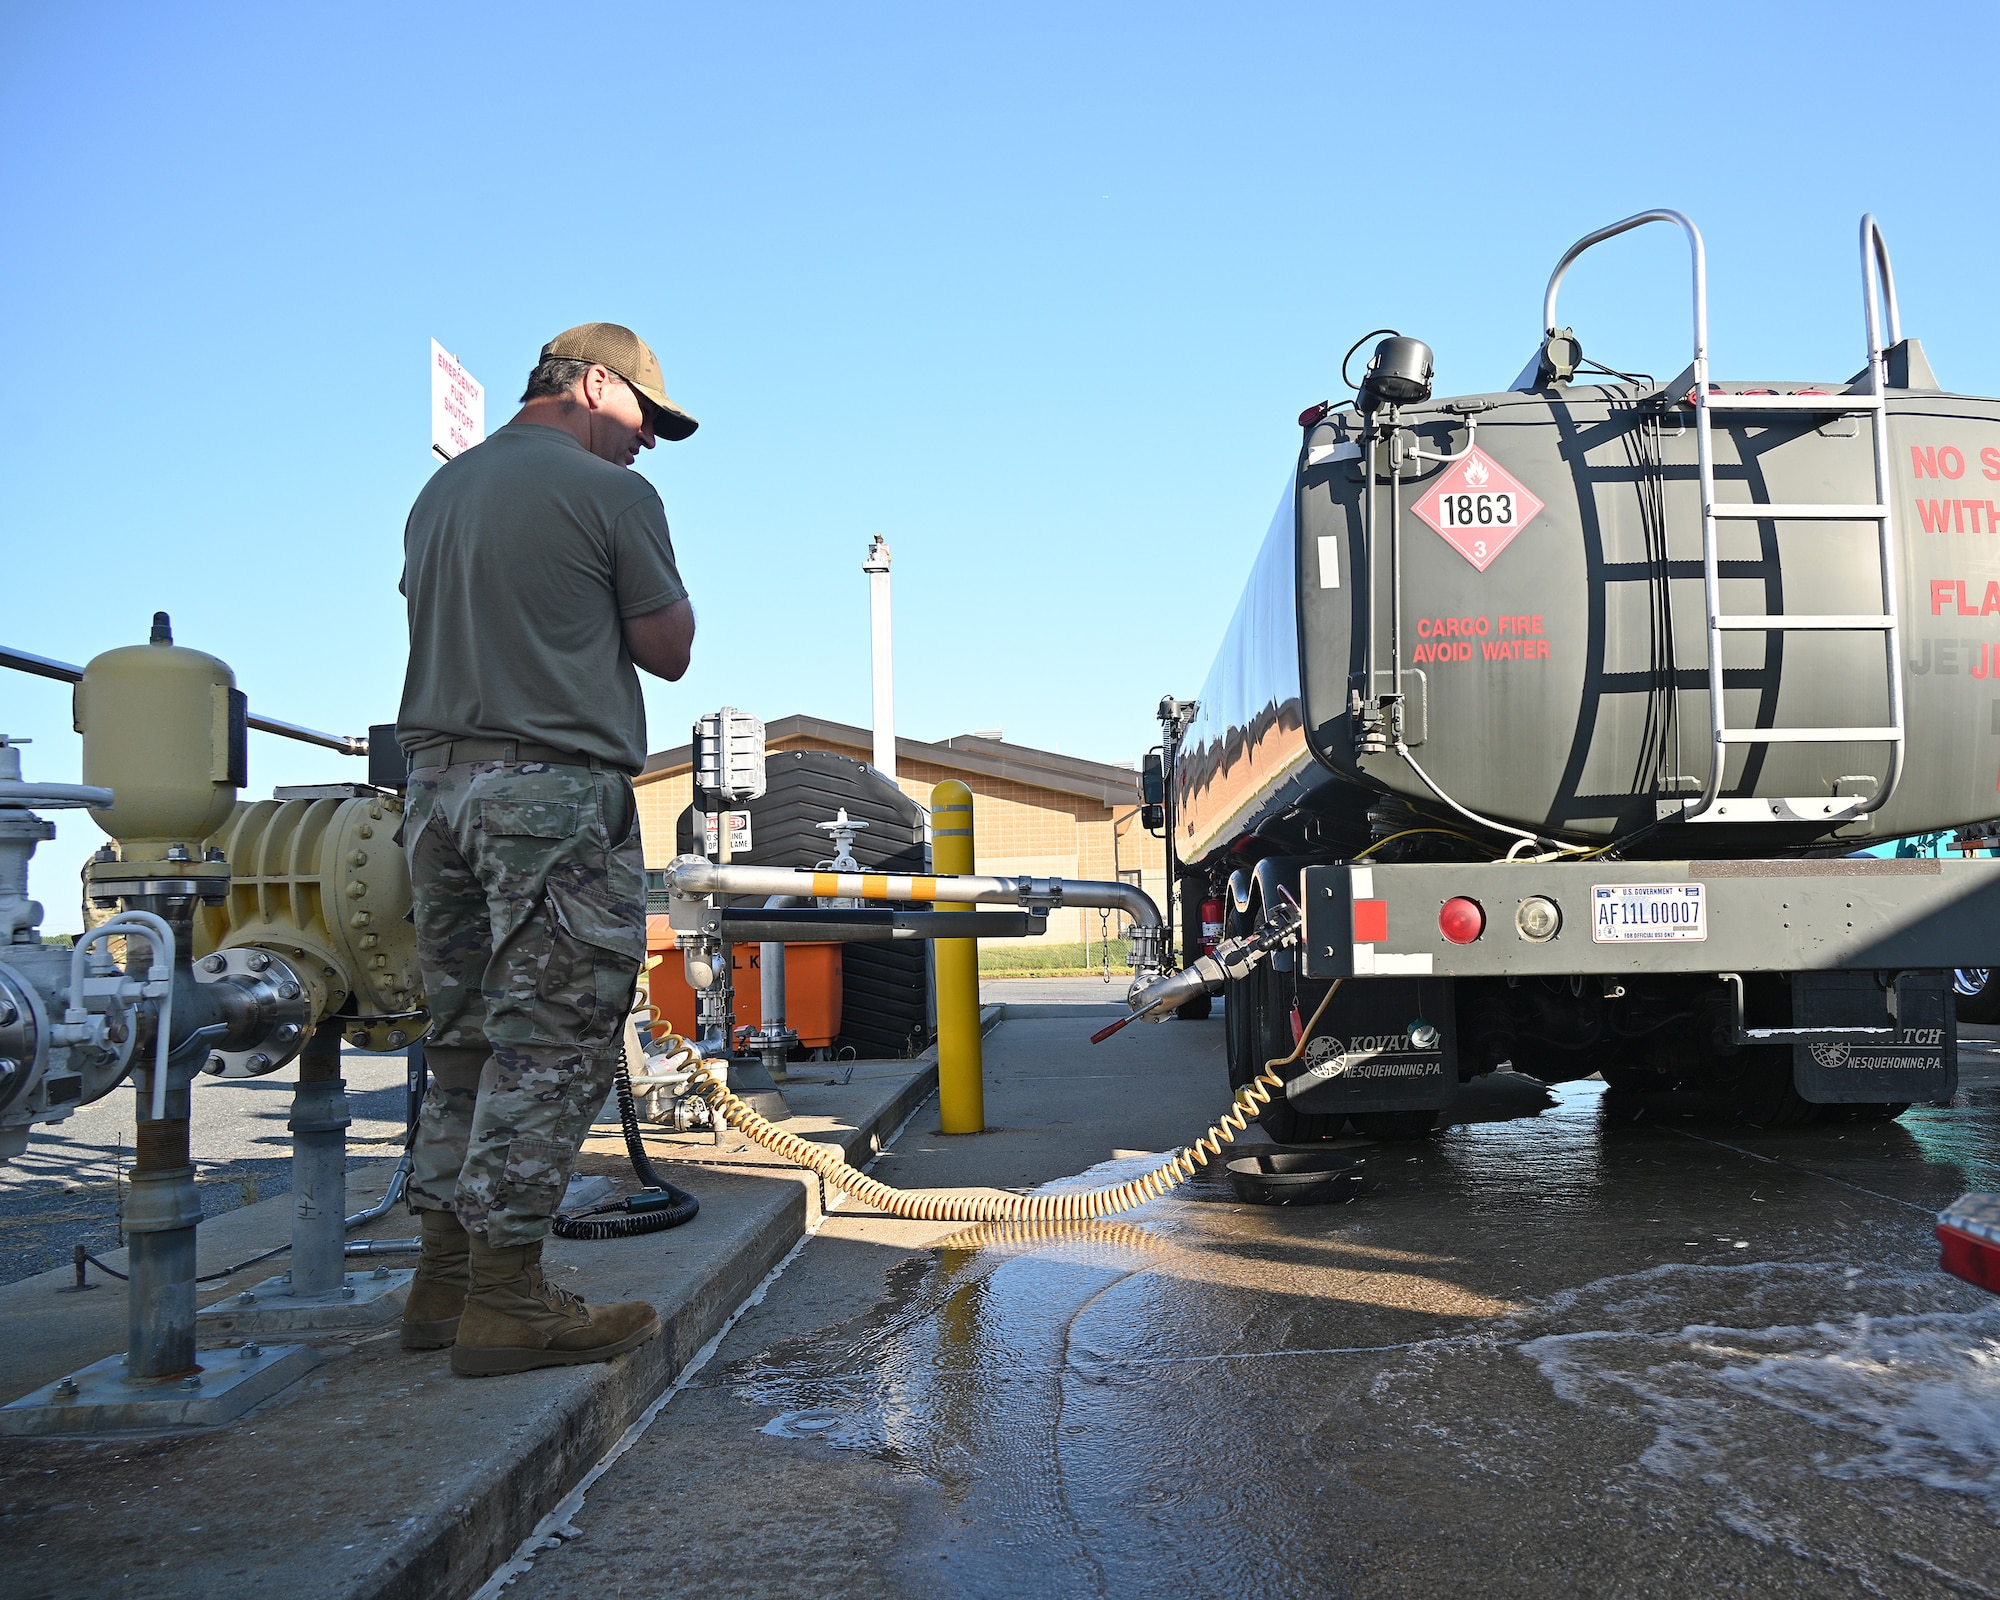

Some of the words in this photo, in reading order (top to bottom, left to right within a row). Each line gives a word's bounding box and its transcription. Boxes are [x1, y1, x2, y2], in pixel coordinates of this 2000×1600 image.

[438, 353, 478, 401] EMERGENCY
[450, 383, 467, 409] FUEL
[444, 396, 474, 431] SHUTOFF
[450, 426, 468, 450] PUSH
[1910, 445, 1966, 480] NO
[1444, 494, 1512, 525] 1863
[1473, 540, 1487, 558] 3
[1417, 616, 1490, 638] CARGO
[1498, 615, 1545, 635] FIRE
[1413, 642, 1473, 663] AVOID
[1481, 639, 1551, 660] WATER
[1622, 888, 1633, 896] U.S.
[1634, 887, 1673, 895] GOVERNMENT
[1599, 901, 1699, 925] AF11L00007
